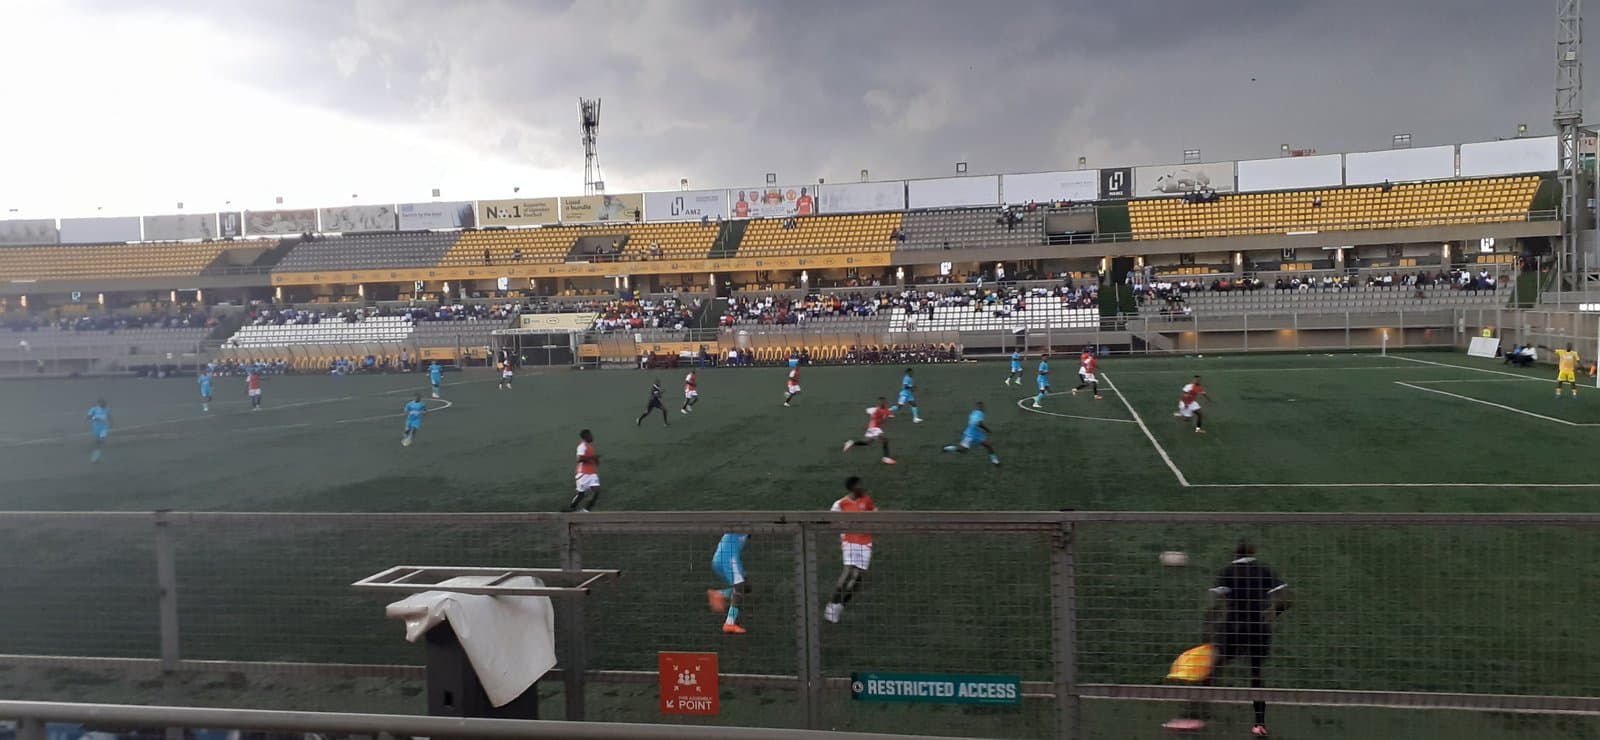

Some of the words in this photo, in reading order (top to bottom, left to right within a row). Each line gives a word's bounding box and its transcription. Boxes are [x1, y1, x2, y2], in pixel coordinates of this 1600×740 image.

[867, 679, 955, 697] RESTRICTED
[958, 682, 1017, 698] ACCESS
[679, 700, 713, 710] POINT
